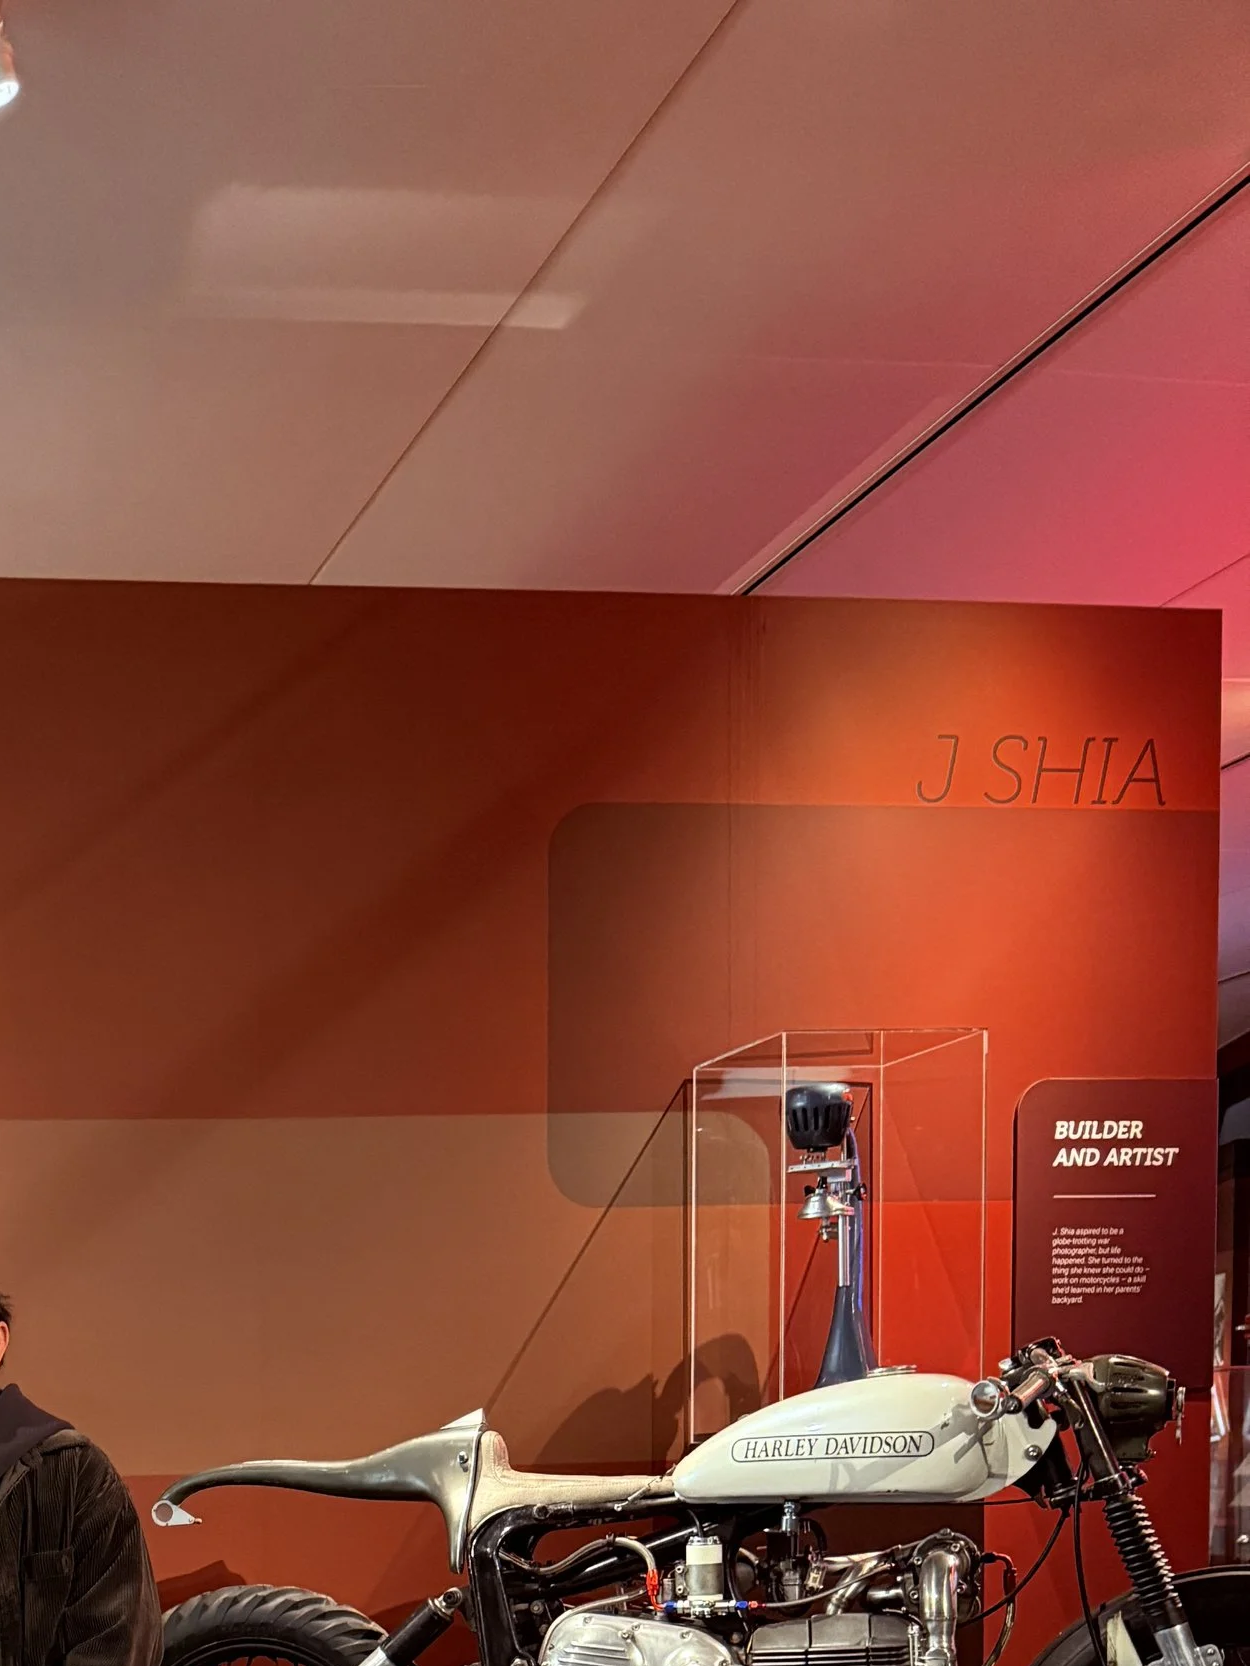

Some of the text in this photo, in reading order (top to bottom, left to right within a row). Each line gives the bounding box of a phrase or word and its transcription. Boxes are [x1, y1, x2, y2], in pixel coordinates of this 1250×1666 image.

[916, 734, 1166, 806] J SHIA
[1054, 1120, 1144, 1140] BUILDER
[1053, 1147, 1179, 1167] AND ARTIST
[1060, 1227, 1075, 1235] Shia
[1075, 1227, 1101, 1236] aspired
[1101, 1227, 1109, 1235] to
[1109, 1227, 1118, 1235] be
[1098, 1247, 1110, 1255] but
[1110, 1246, 1122, 1254] life
[1087, 1256, 1100, 1264] She
[1101, 1256, 1123, 1264] turned
[1052, 1267, 1069, 1276] thing
[1070, 1266, 1083, 1274] she
[1083, 1266, 1101, 1274] knew
[1102, 1266, 1115, 1274] she
[1115, 1266, 1134, 1274] could
[1134, 1265, 1144, 1273] do
[1079, 1276, 1120, 1285] motorcycles
[1133, 1275, 1147, 1283] skill
[1070, 1286, 1095, 1294] learned
[1103, 1285, 1114, 1293] her
[744, 1435, 923, 1459] HARLEY DAVIDSON
